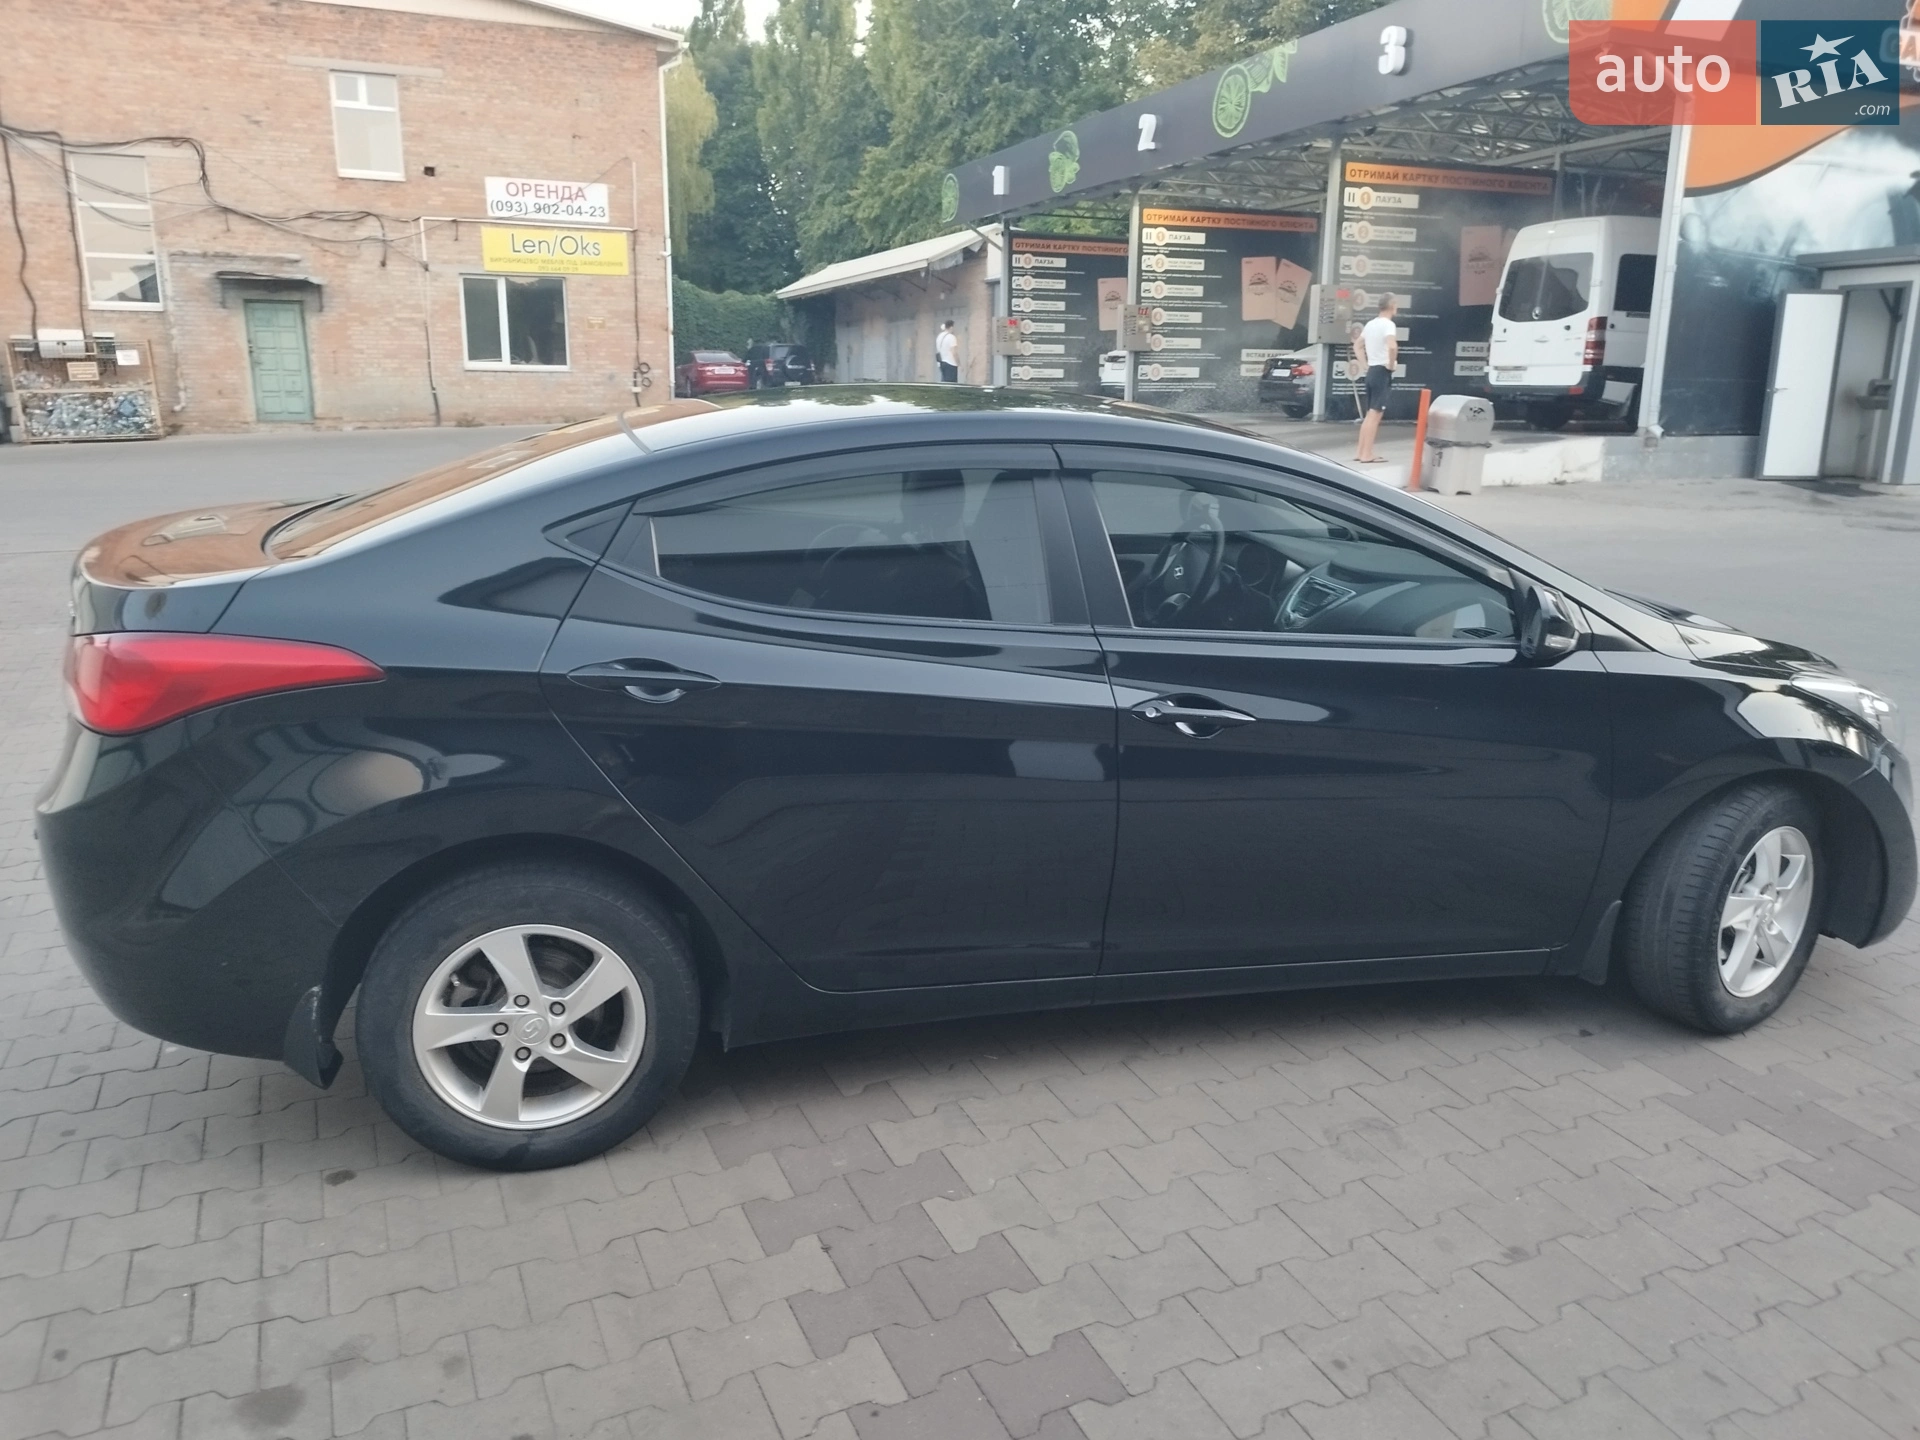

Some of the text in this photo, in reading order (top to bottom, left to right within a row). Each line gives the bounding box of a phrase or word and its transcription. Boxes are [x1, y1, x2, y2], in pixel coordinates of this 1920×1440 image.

[1378, 25, 1407, 76] 3
[1138, 114, 1157, 151] 2
[992, 165, 1005, 196] 1
[1349, 167, 1400, 181] ОТРИМАЙ
[1402, 171, 1440, 184] КАРТКУ
[1442, 174, 1506, 188] ПОСТІЙНОГО
[505, 181, 588, 204] ОРЕНДА
[1375, 195, 1402, 204] ПАУЗА
[490, 199, 606, 218] (093) 902-04-23
[1145, 212, 1189, 223] ОТРИМАЙ
[1190, 215, 1222, 225] КАРТКУ
[1224, 217, 1278, 228] ПОСТІЙНОГО
[511, 232, 602, 257] Len/Oks
[1014, 241, 1051, 250] ОТРИМАЙ
[1052, 244, 1080, 252] КАРТКУ
[1461, 345, 1484, 353] ВСТАВ
